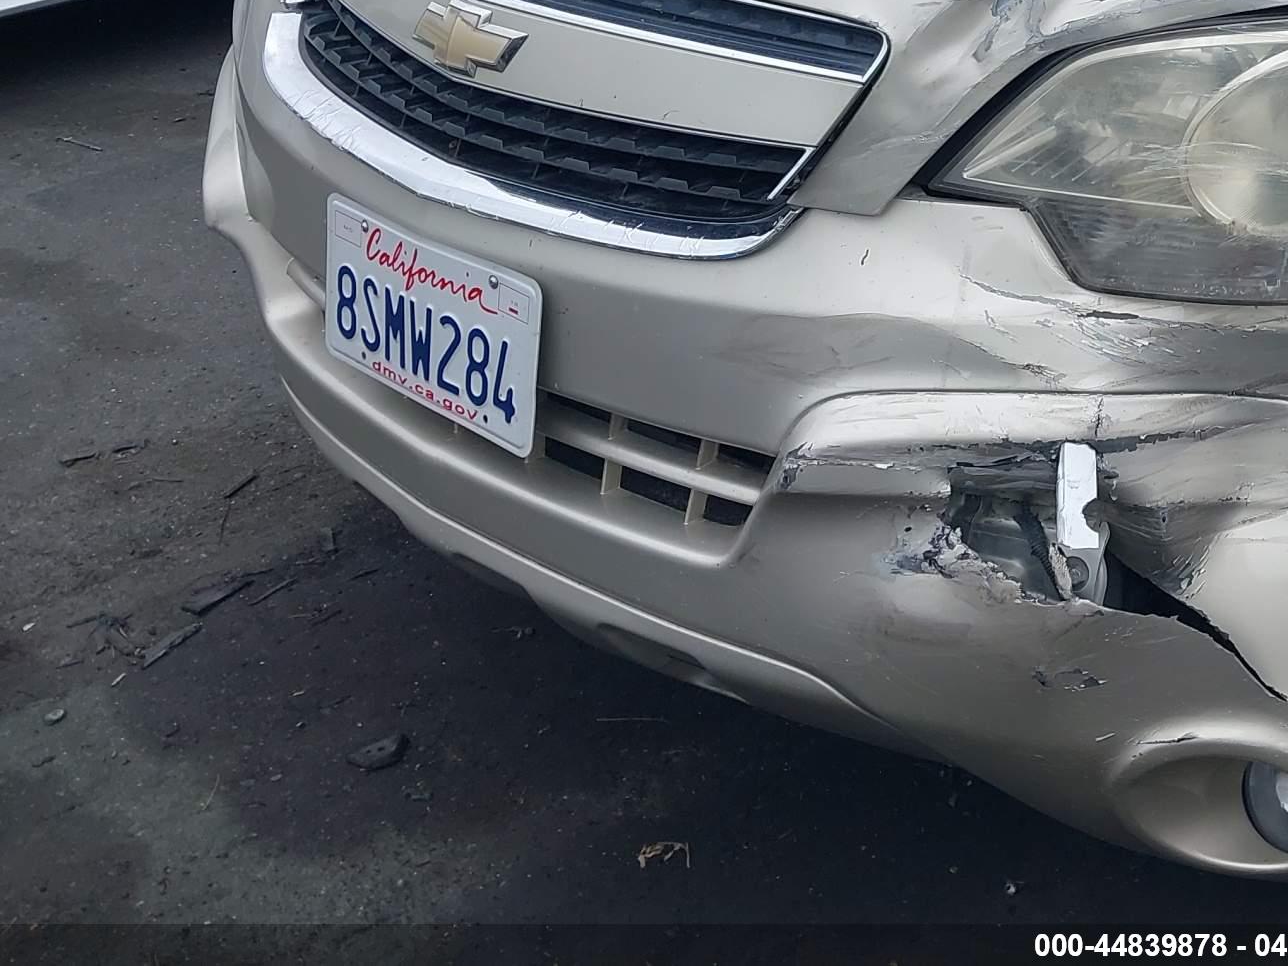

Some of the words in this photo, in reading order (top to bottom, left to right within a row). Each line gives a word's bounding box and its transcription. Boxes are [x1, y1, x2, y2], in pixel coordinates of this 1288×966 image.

[366, 228, 498, 315] California
[337, 265, 516, 424] 8SMW284
[372, 360, 478, 420] dmv.ca.gov
